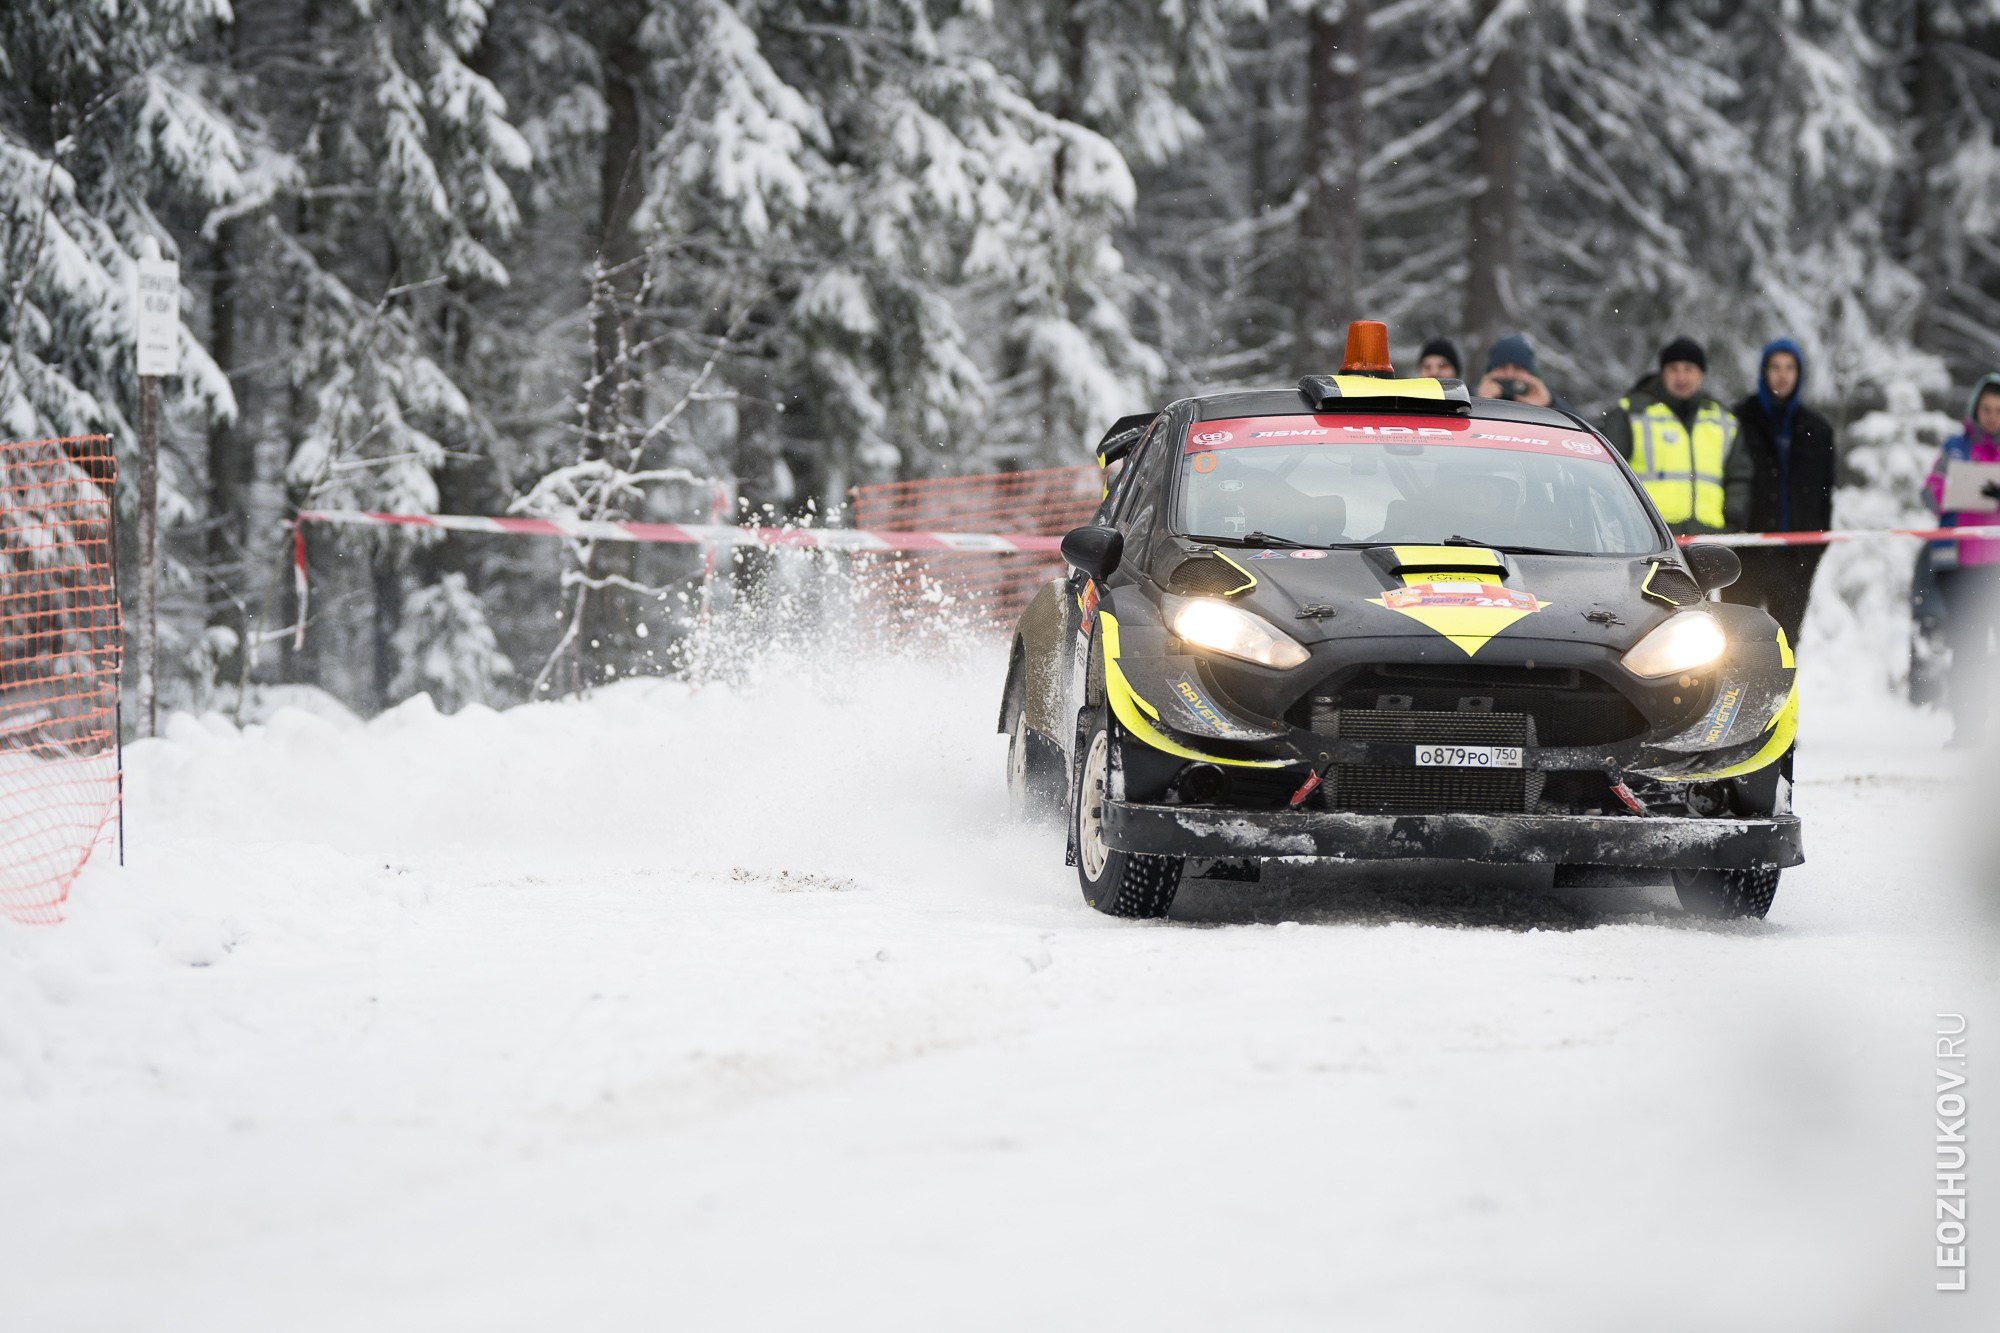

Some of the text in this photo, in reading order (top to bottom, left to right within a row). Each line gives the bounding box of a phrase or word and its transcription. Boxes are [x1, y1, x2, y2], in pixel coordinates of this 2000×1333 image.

[1254, 429, 1329, 439] ASMG
[1478, 433, 1550, 446] ASMG
[1475, 597, 1513, 607] 24
[1494, 748, 1517, 760] 750
